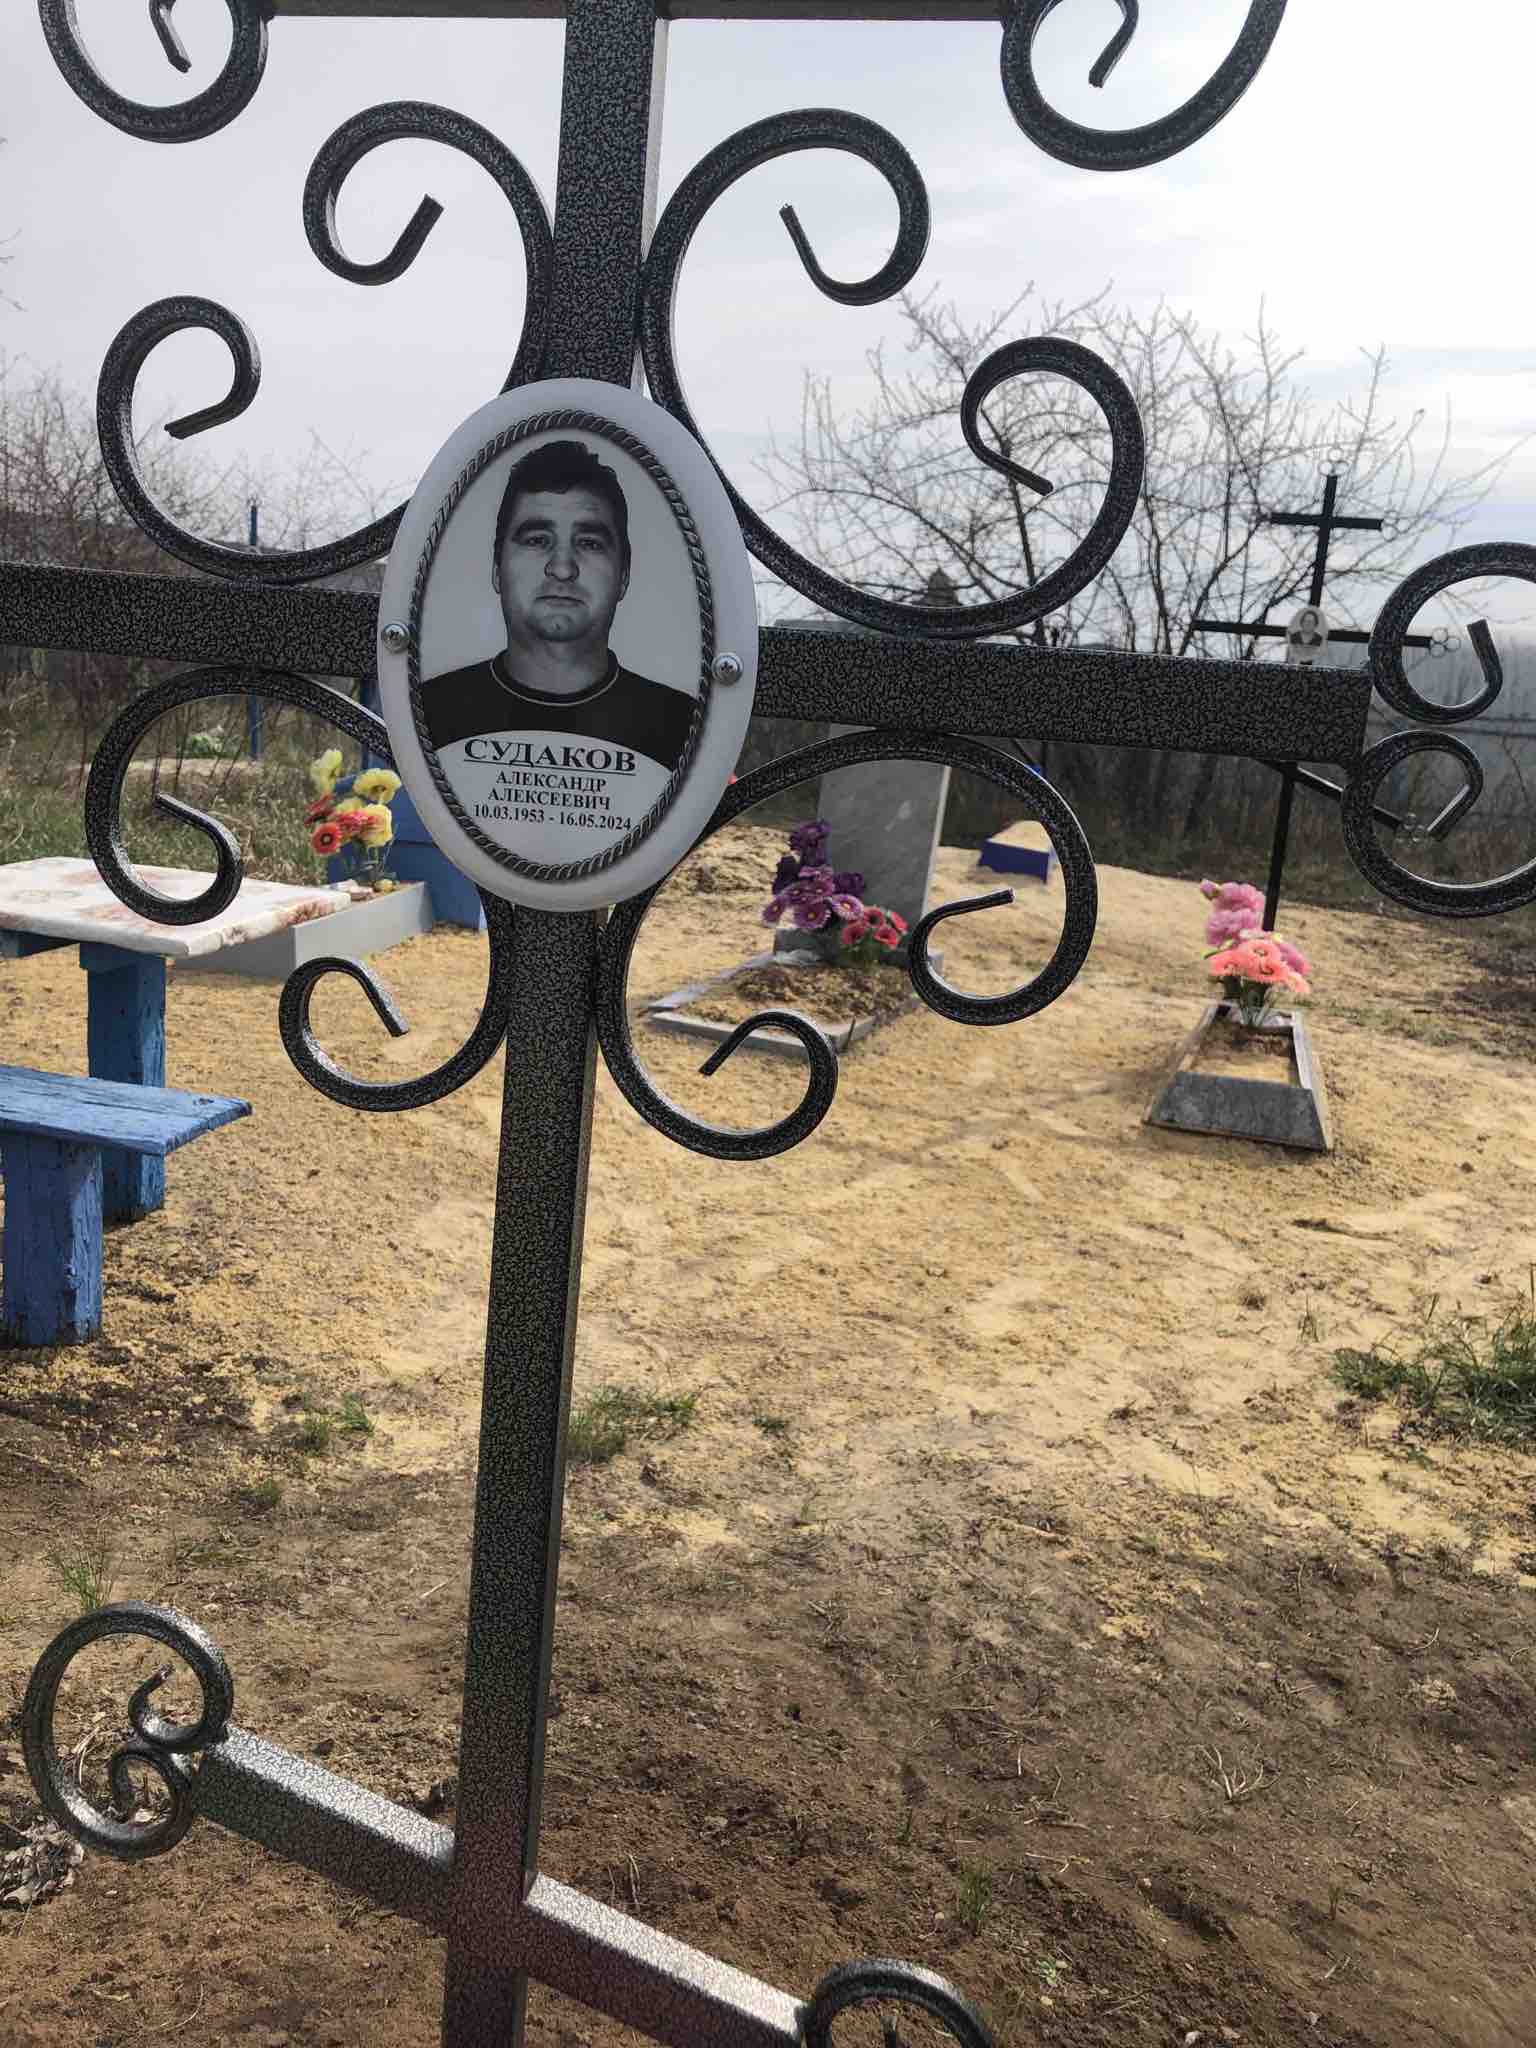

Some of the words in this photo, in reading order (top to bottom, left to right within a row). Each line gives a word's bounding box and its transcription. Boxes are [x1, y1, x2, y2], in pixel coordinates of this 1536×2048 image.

[464, 738, 636, 772] СУДАКОВ
[496, 770, 607, 793] АЛЕКСАНДР
[488, 787, 610, 810] АЛЕКСЕЕВИЧ
[474, 804, 545, 824] 10.03.1953
[560, 811, 632, 831] 16.05.2024
